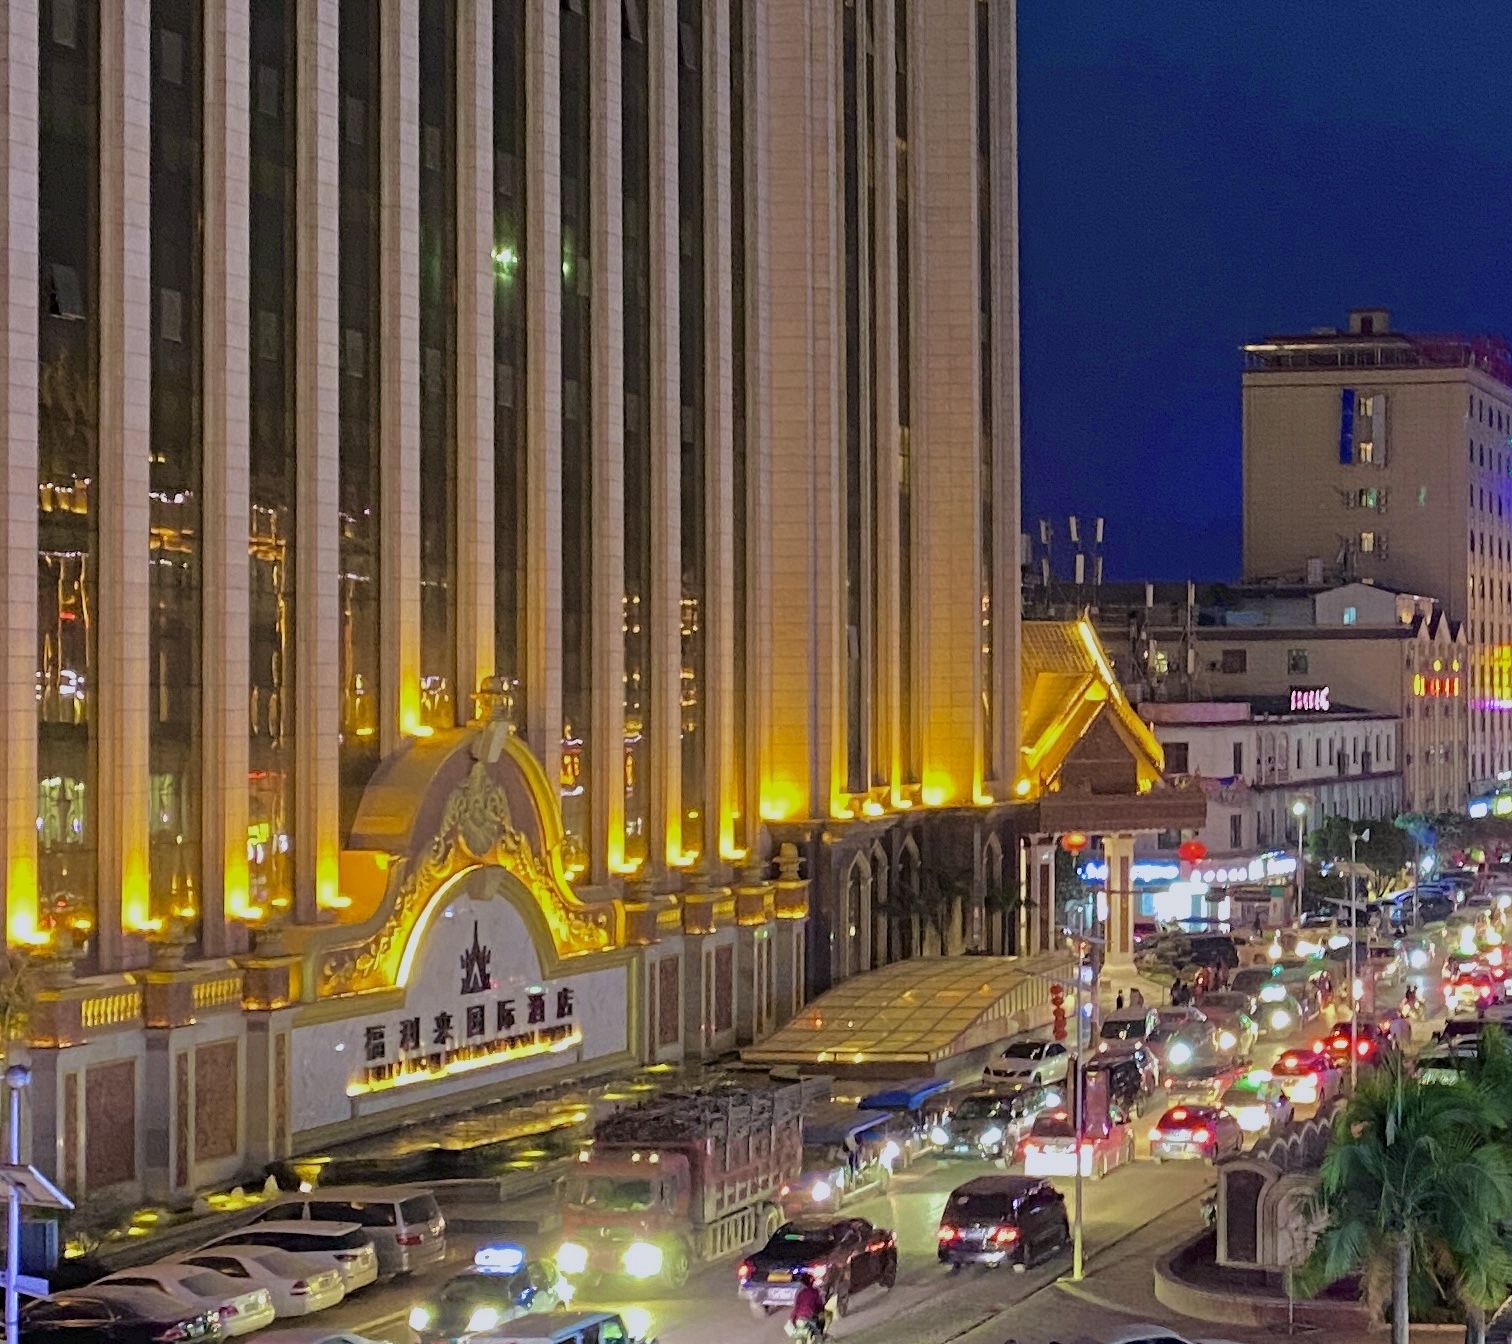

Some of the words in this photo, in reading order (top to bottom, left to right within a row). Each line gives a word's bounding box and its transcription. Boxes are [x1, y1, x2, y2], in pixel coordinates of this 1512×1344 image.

[365, 987, 574, 1061] 福利来国际酒店
